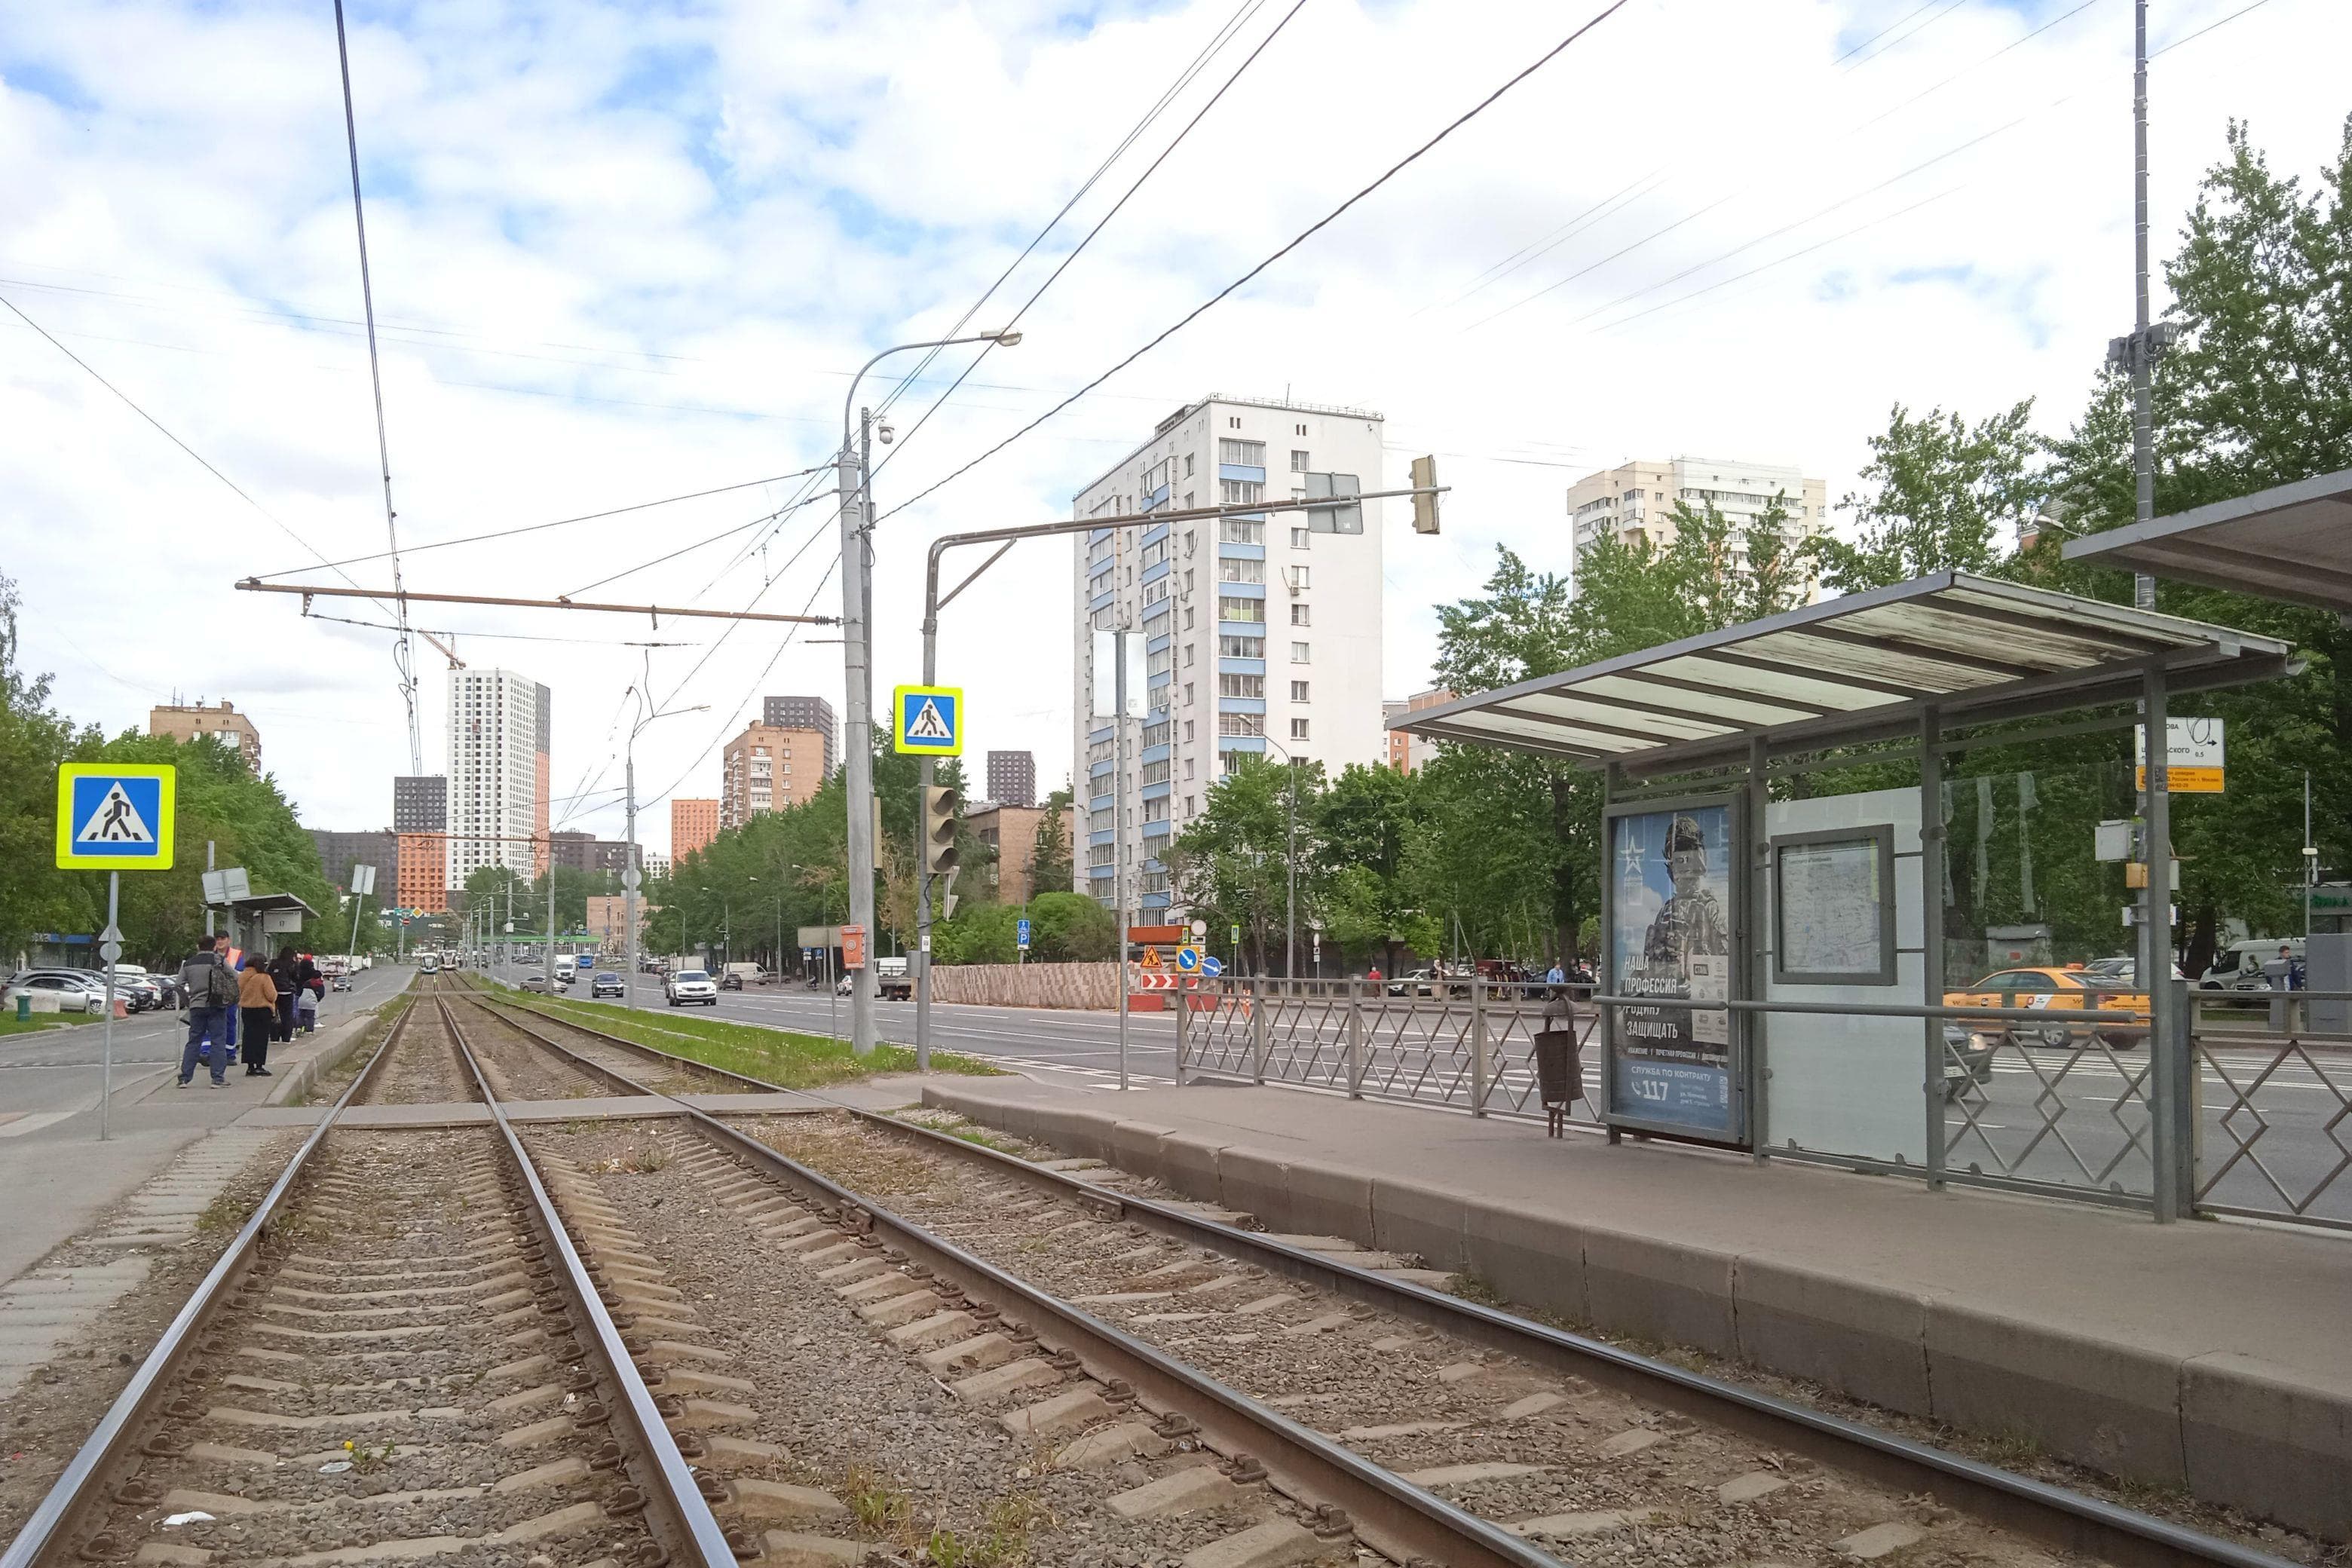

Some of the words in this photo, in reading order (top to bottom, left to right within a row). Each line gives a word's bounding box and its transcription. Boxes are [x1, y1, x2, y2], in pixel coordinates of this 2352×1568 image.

[1020, 933, 1027, 943] P
[1624, 955, 1649, 971] НАША
[1625, 977, 1677, 994] ПРОФЕССИЯ
[1626, 1021, 1678, 1040] ЗАЩИЩАТЬ
[1631, 1066, 1660, 1076] СЛУЖБА
[1662, 1069, 1673, 1077] ПО
[1674, 1070, 1712, 1082] КОНТРАКТУ
[1643, 1080, 1668, 1101] 117
